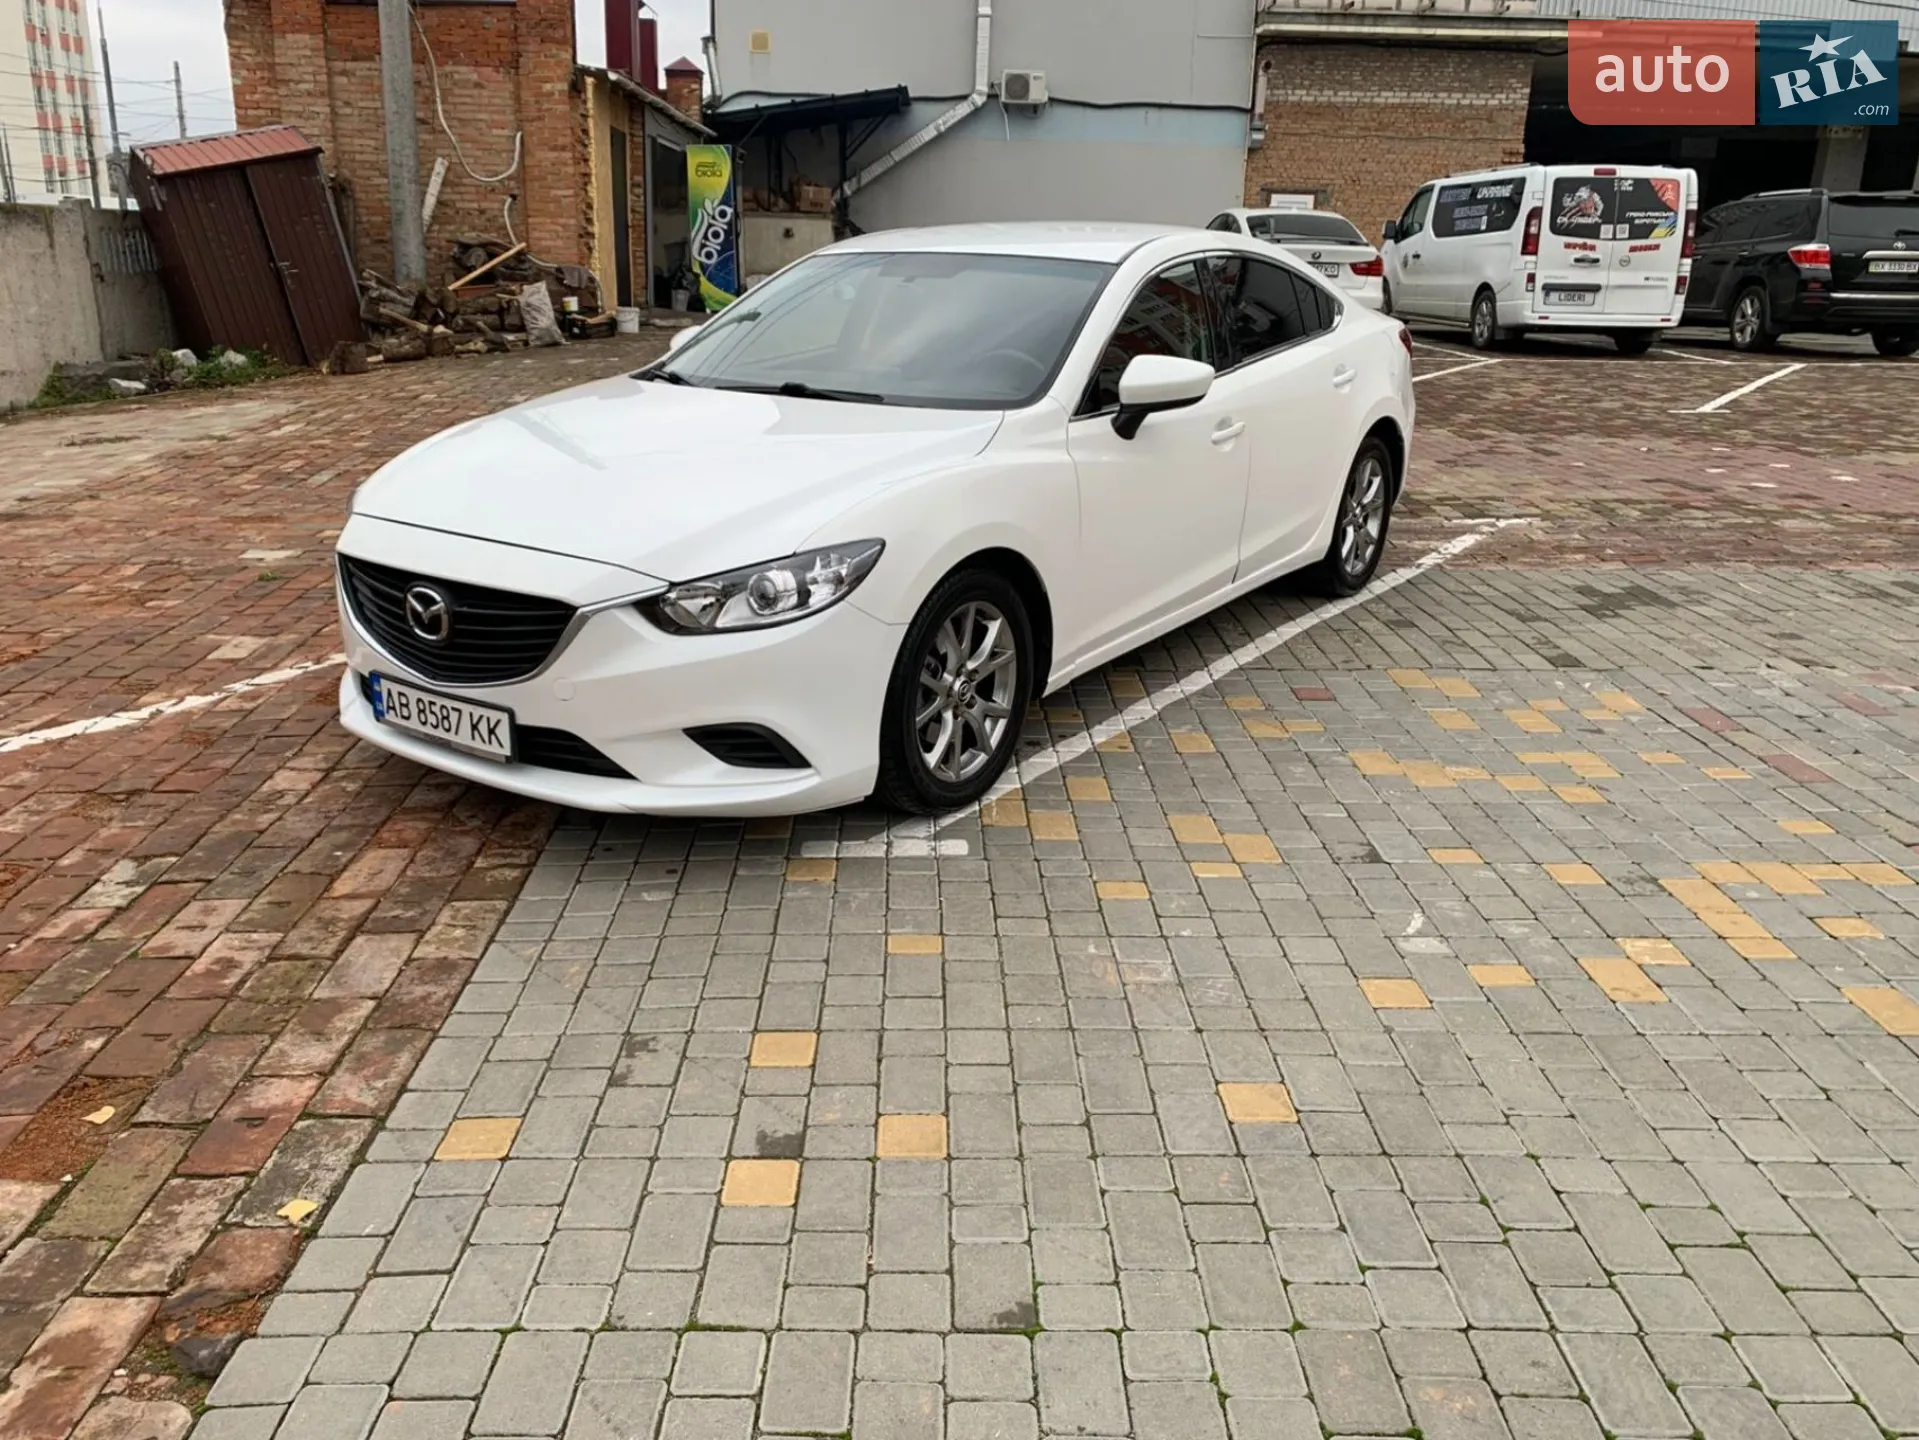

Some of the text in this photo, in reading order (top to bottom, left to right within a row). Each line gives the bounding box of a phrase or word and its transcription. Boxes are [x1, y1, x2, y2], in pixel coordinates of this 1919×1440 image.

[692, 203, 734, 265] biola
[385, 687, 504, 749] AB 8587 KK
